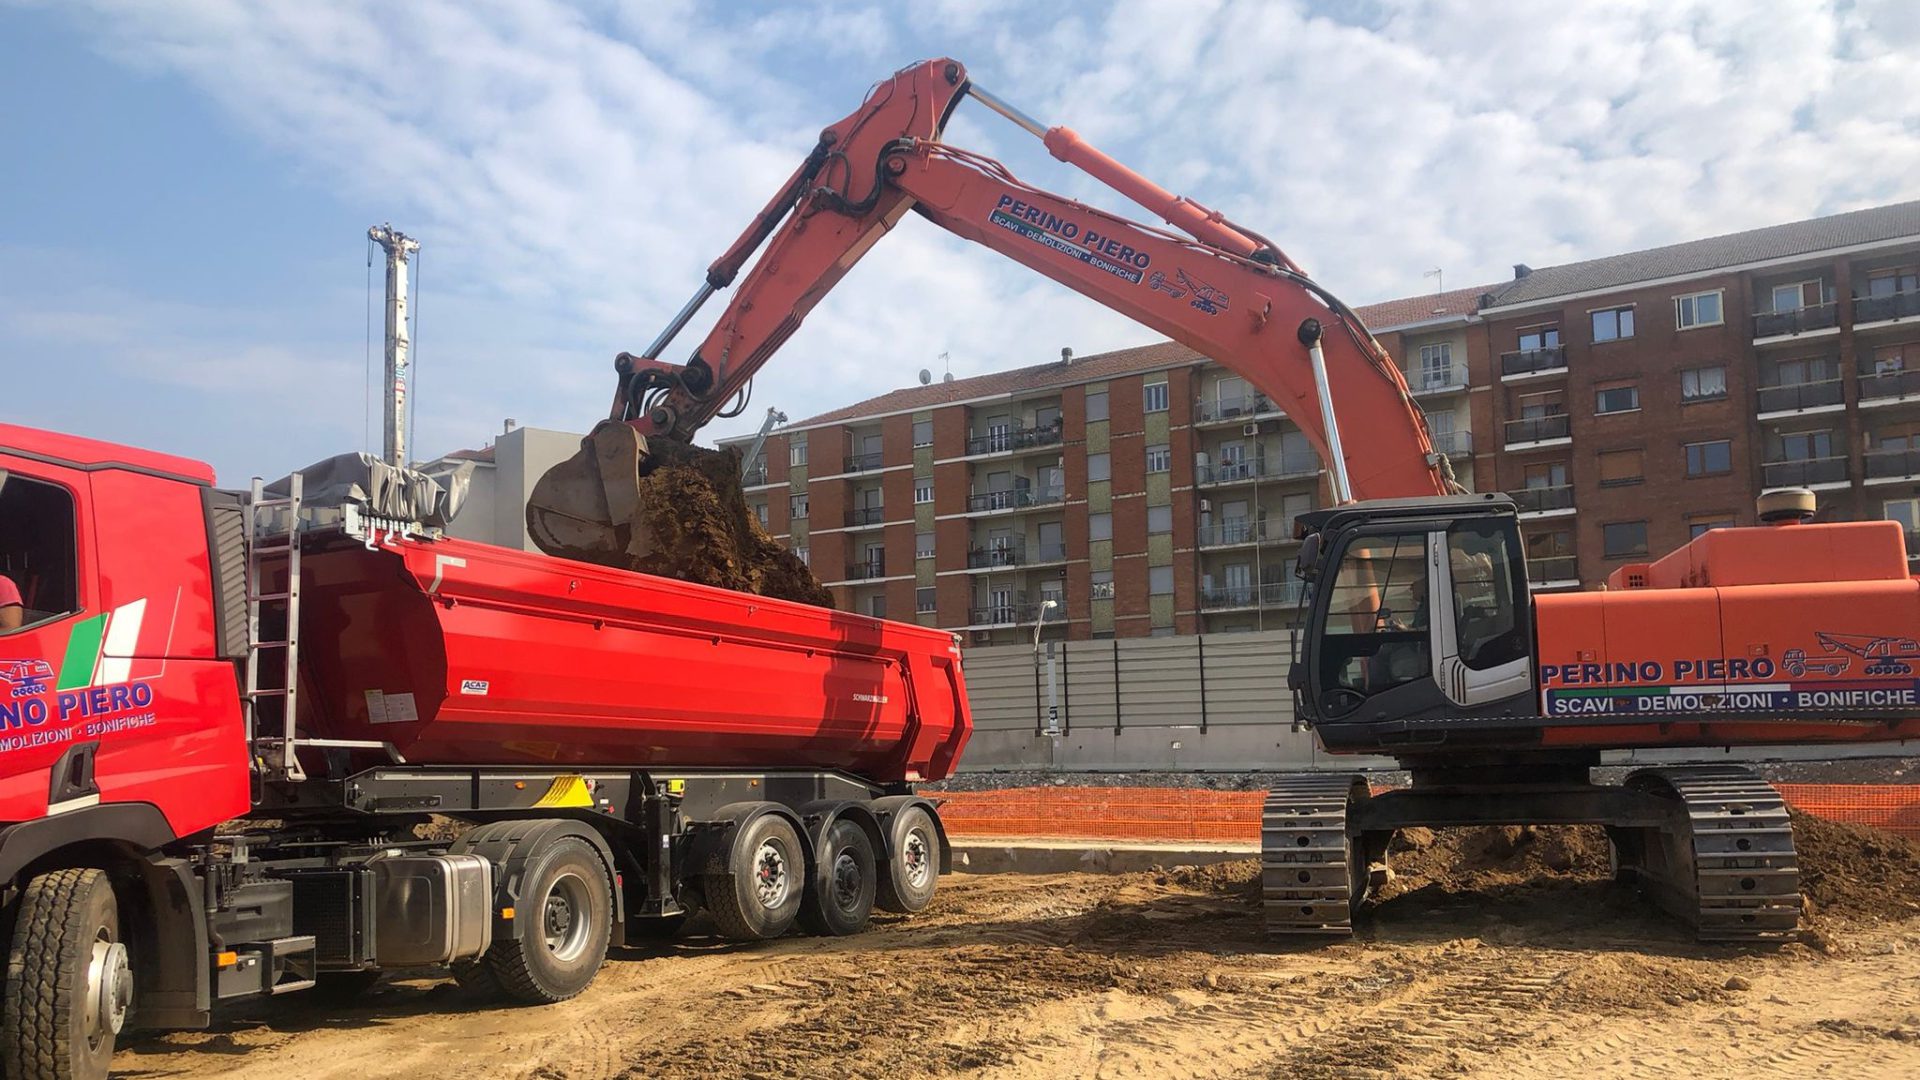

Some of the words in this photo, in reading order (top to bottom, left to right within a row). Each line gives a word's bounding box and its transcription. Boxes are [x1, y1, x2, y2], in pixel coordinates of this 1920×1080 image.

[997, 194, 1079, 239] PERINO
[1083, 230, 1151, 270] PIERO
[992, 215, 1019, 232] SCAVI
[1026, 230, 1082, 259] DEMOLIZIONI
[1090, 256, 1138, 283] BONIFICHE
[1541, 661, 1663, 685] PERINO
[1673, 658, 1776, 681] PIERO
[58, 681, 153, 721] PIERO
[1555, 697, 1613, 713] SCAVI
[1798, 689, 1917, 708] BONIFICHE
[86, 713, 157, 737] BONIFICHE
